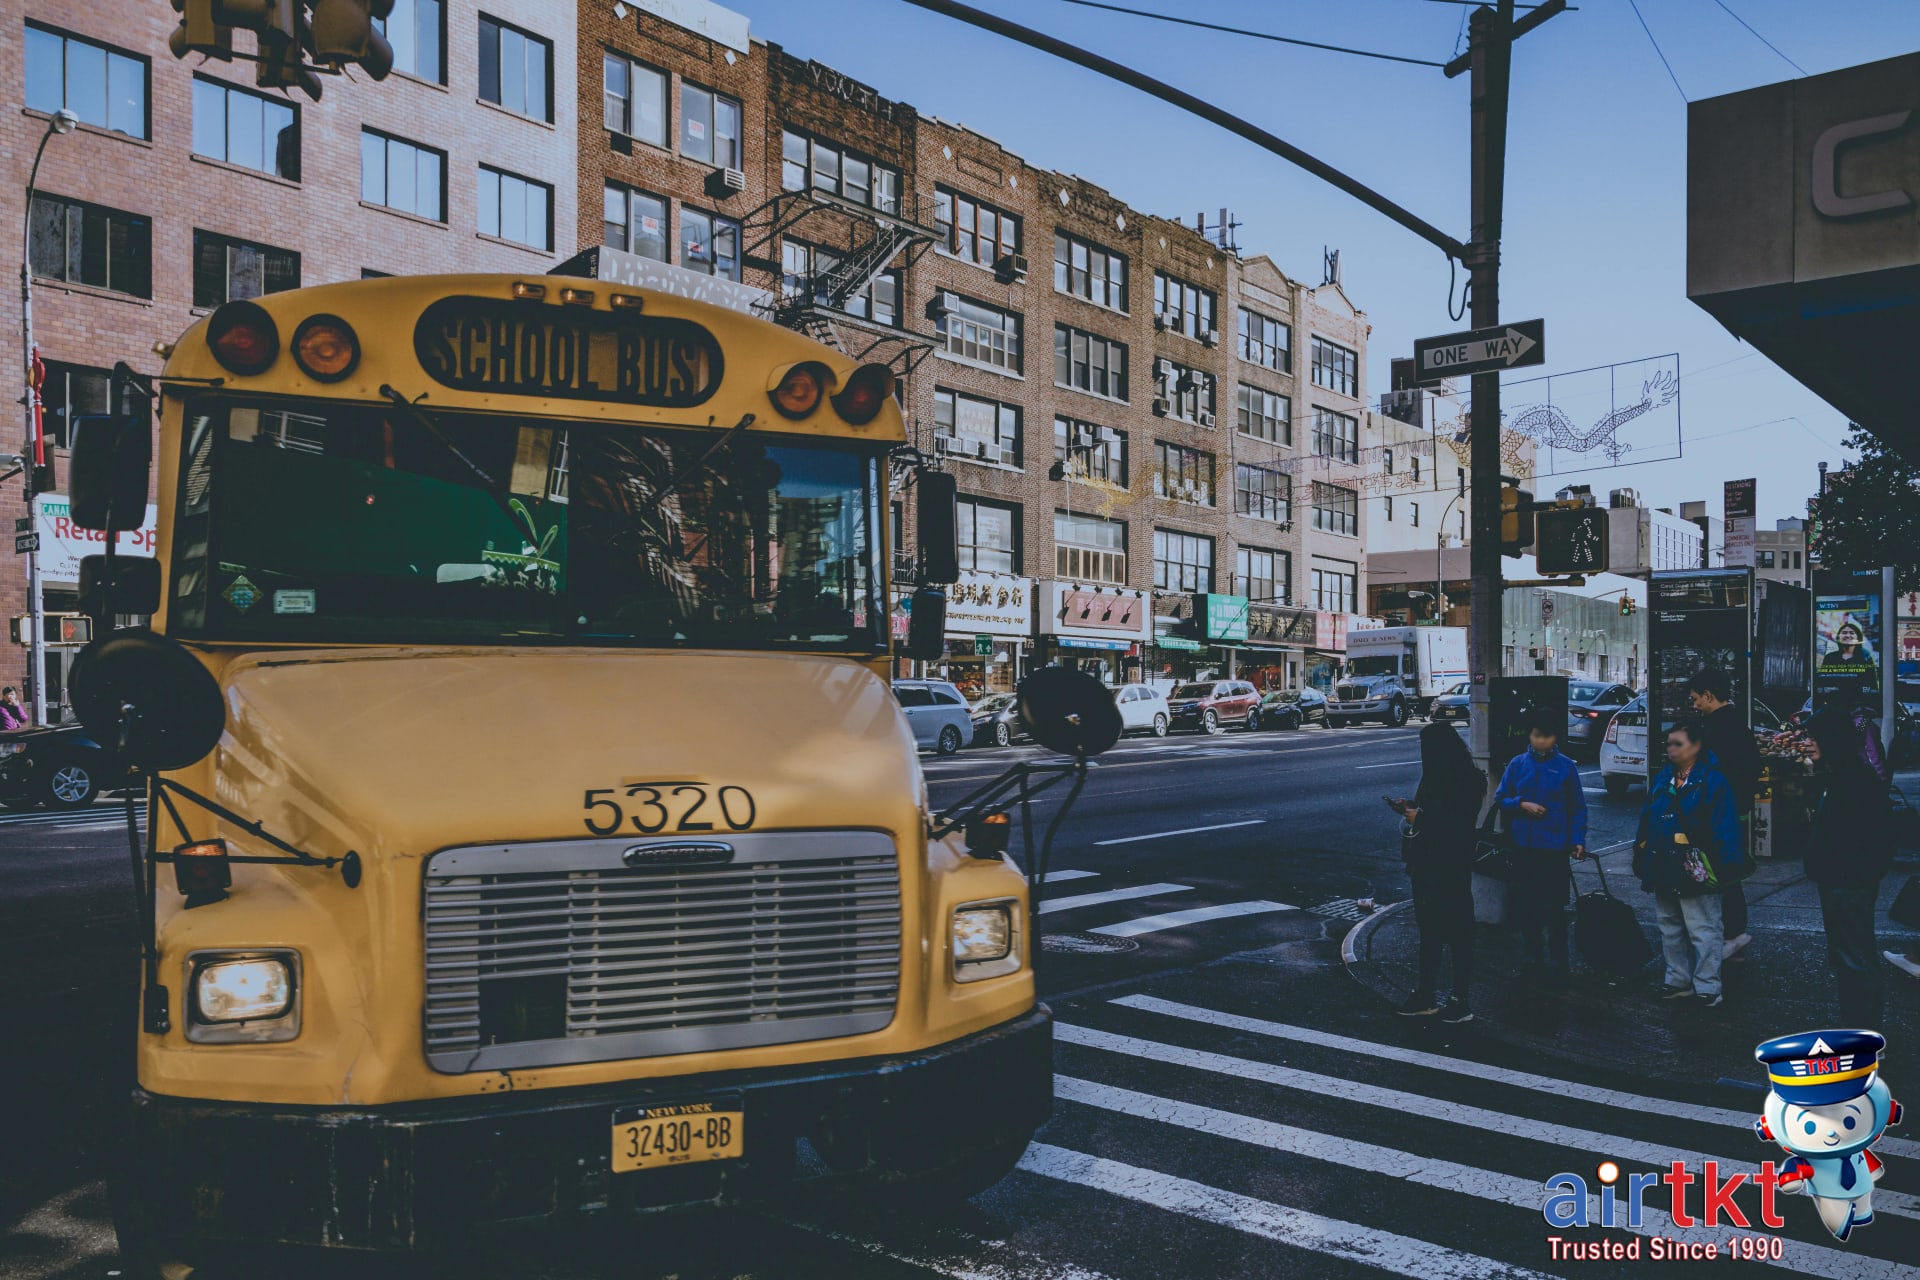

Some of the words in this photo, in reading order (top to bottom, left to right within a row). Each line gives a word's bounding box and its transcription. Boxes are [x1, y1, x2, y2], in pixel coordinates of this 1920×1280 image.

[434, 318, 599, 390] SCHOOL
[617, 326, 699, 398] BUS
[1432, 345, 1469, 366] ONE
[1485, 336, 1524, 358] WAY
[583, 784, 756, 836] 5320
[646, 1106, 677, 1119] NEW
[680, 1103, 712, 1114] YORK
[626, 1120, 691, 1158] 32430
[706, 1116, 732, 1149] BB
